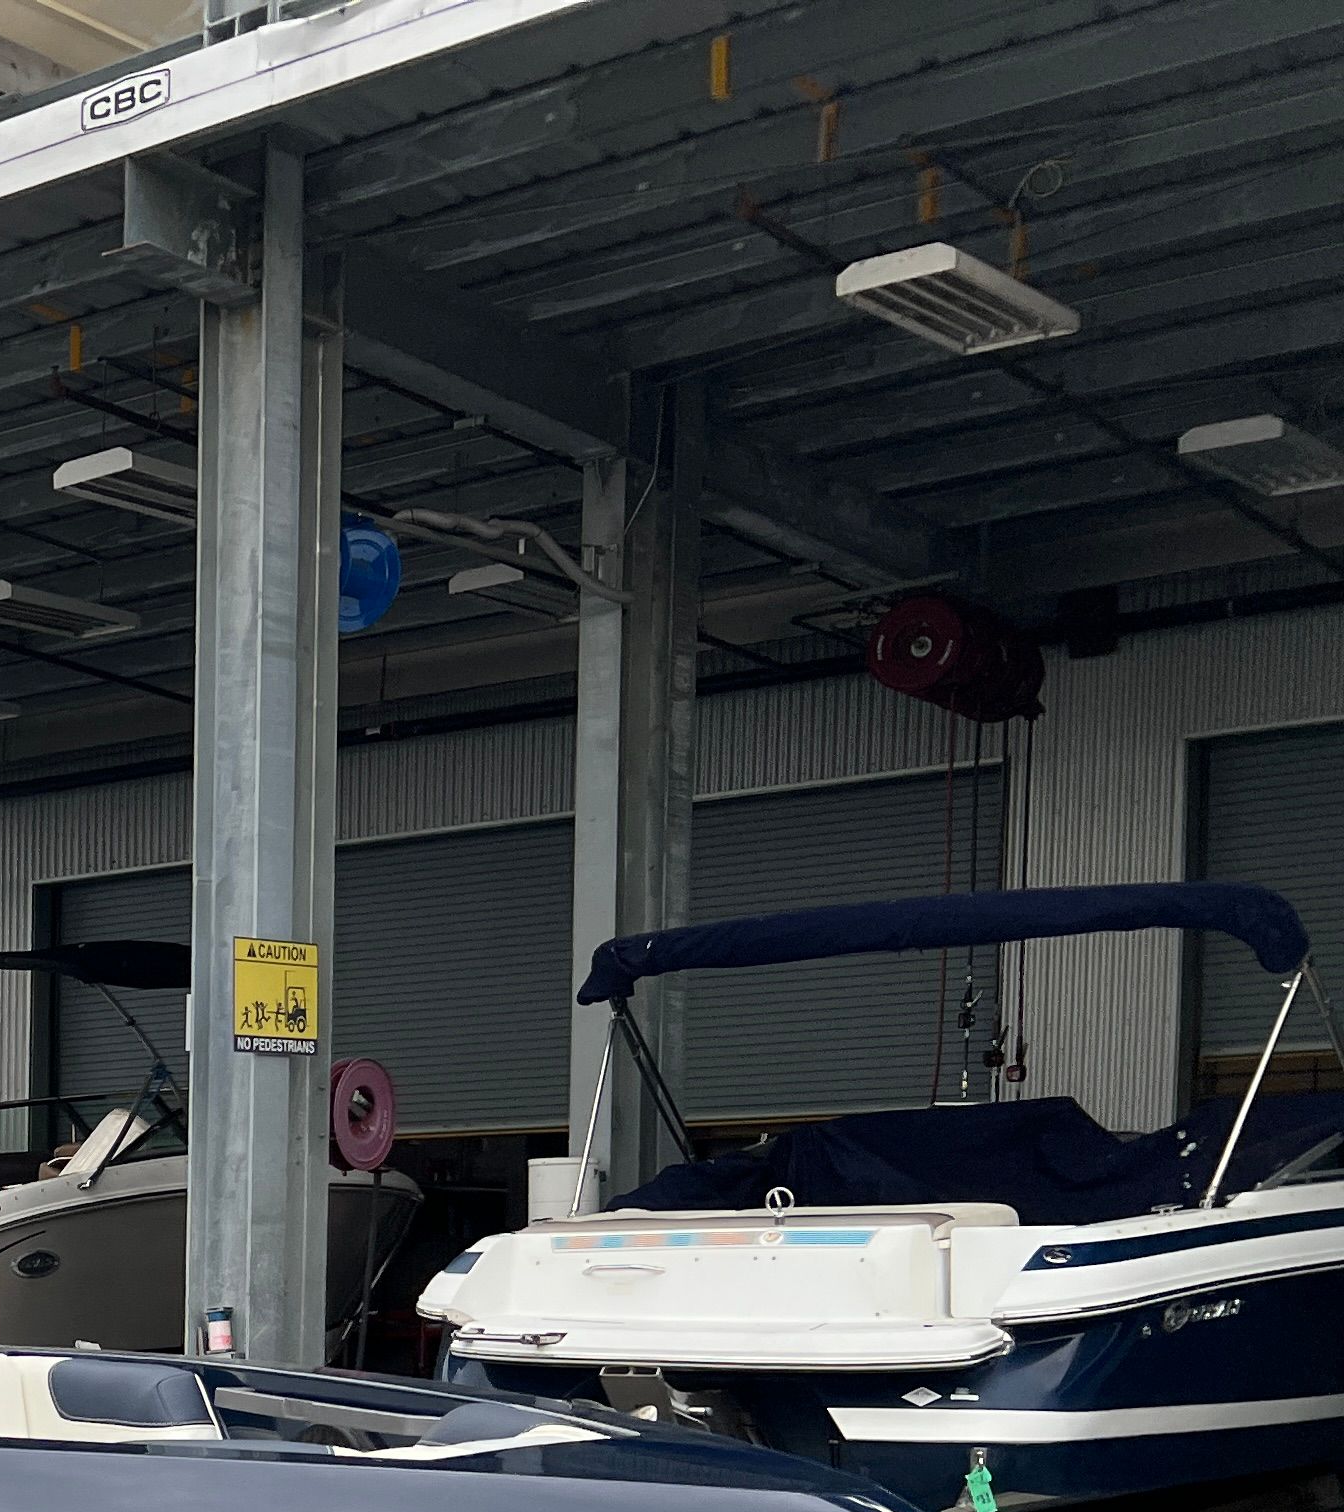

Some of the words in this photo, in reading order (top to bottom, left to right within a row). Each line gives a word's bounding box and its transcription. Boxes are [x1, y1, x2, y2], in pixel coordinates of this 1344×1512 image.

[89, 79, 162, 120] CBC
[258, 943, 307, 961] CAUTION
[237, 1037, 252, 1050] NO
[252, 1037, 315, 1054] PEDESTRIANS
